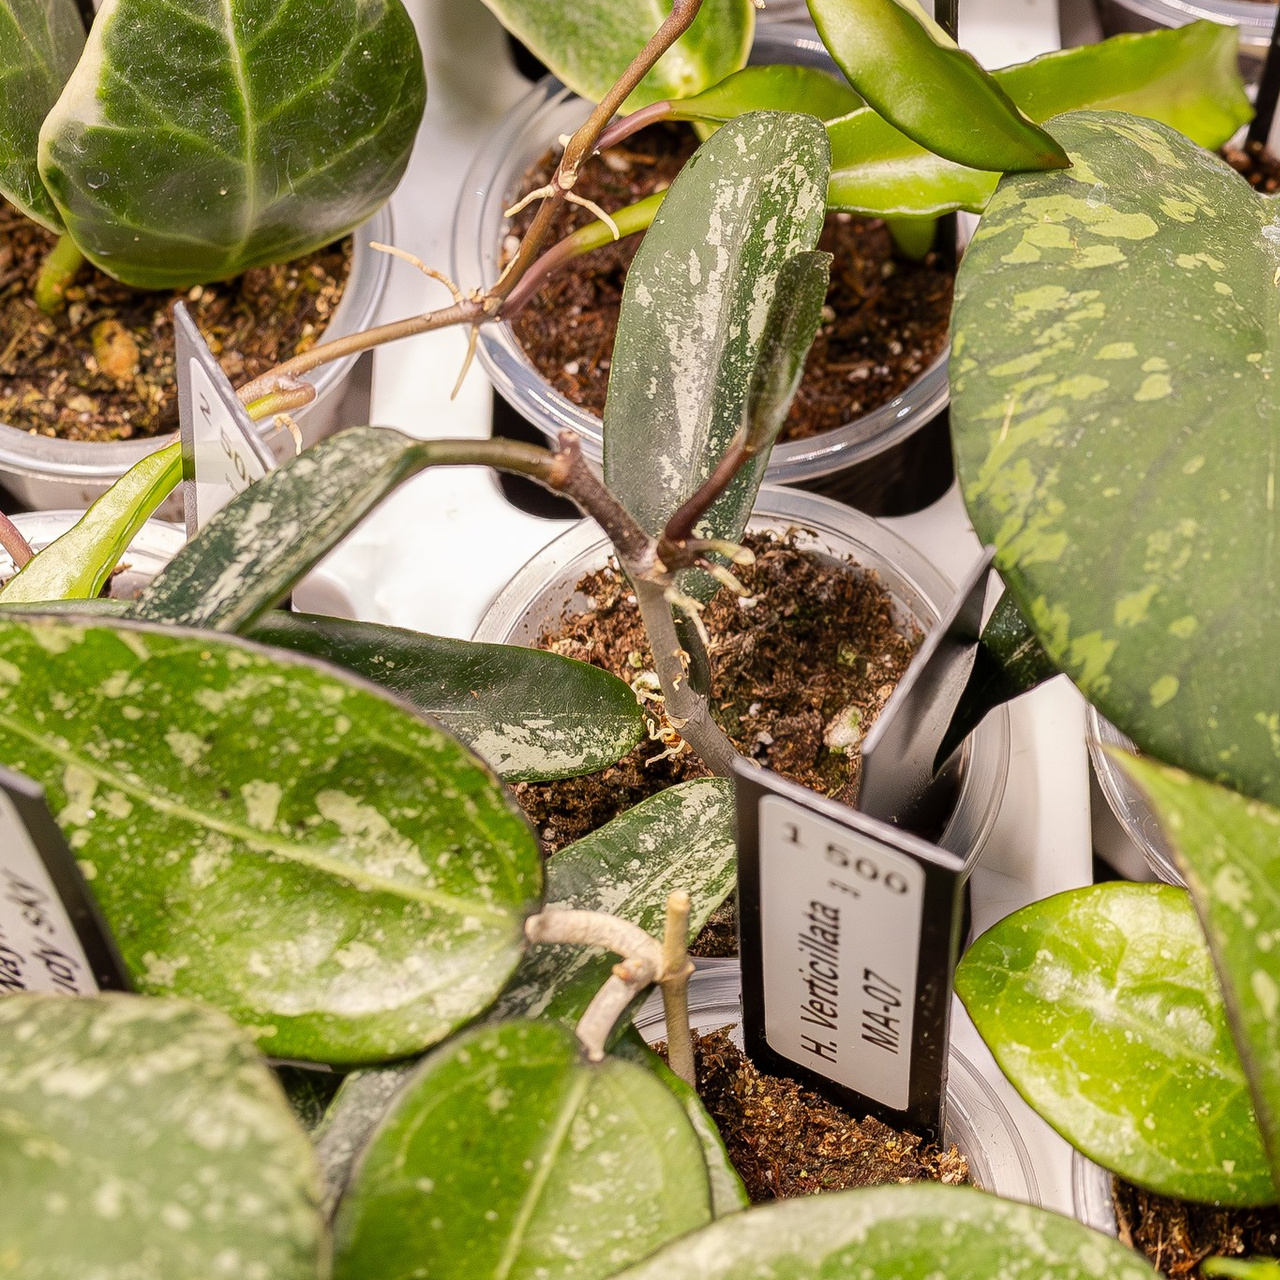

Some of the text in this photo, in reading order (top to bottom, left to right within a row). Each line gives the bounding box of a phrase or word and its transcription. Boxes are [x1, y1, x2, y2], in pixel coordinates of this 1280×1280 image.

[220, 425, 255, 486] 50
[782, 822, 908, 896] 1 500
[797, 898, 842, 1064] H. Verticillata
[860, 967, 903, 1055] MA-07
